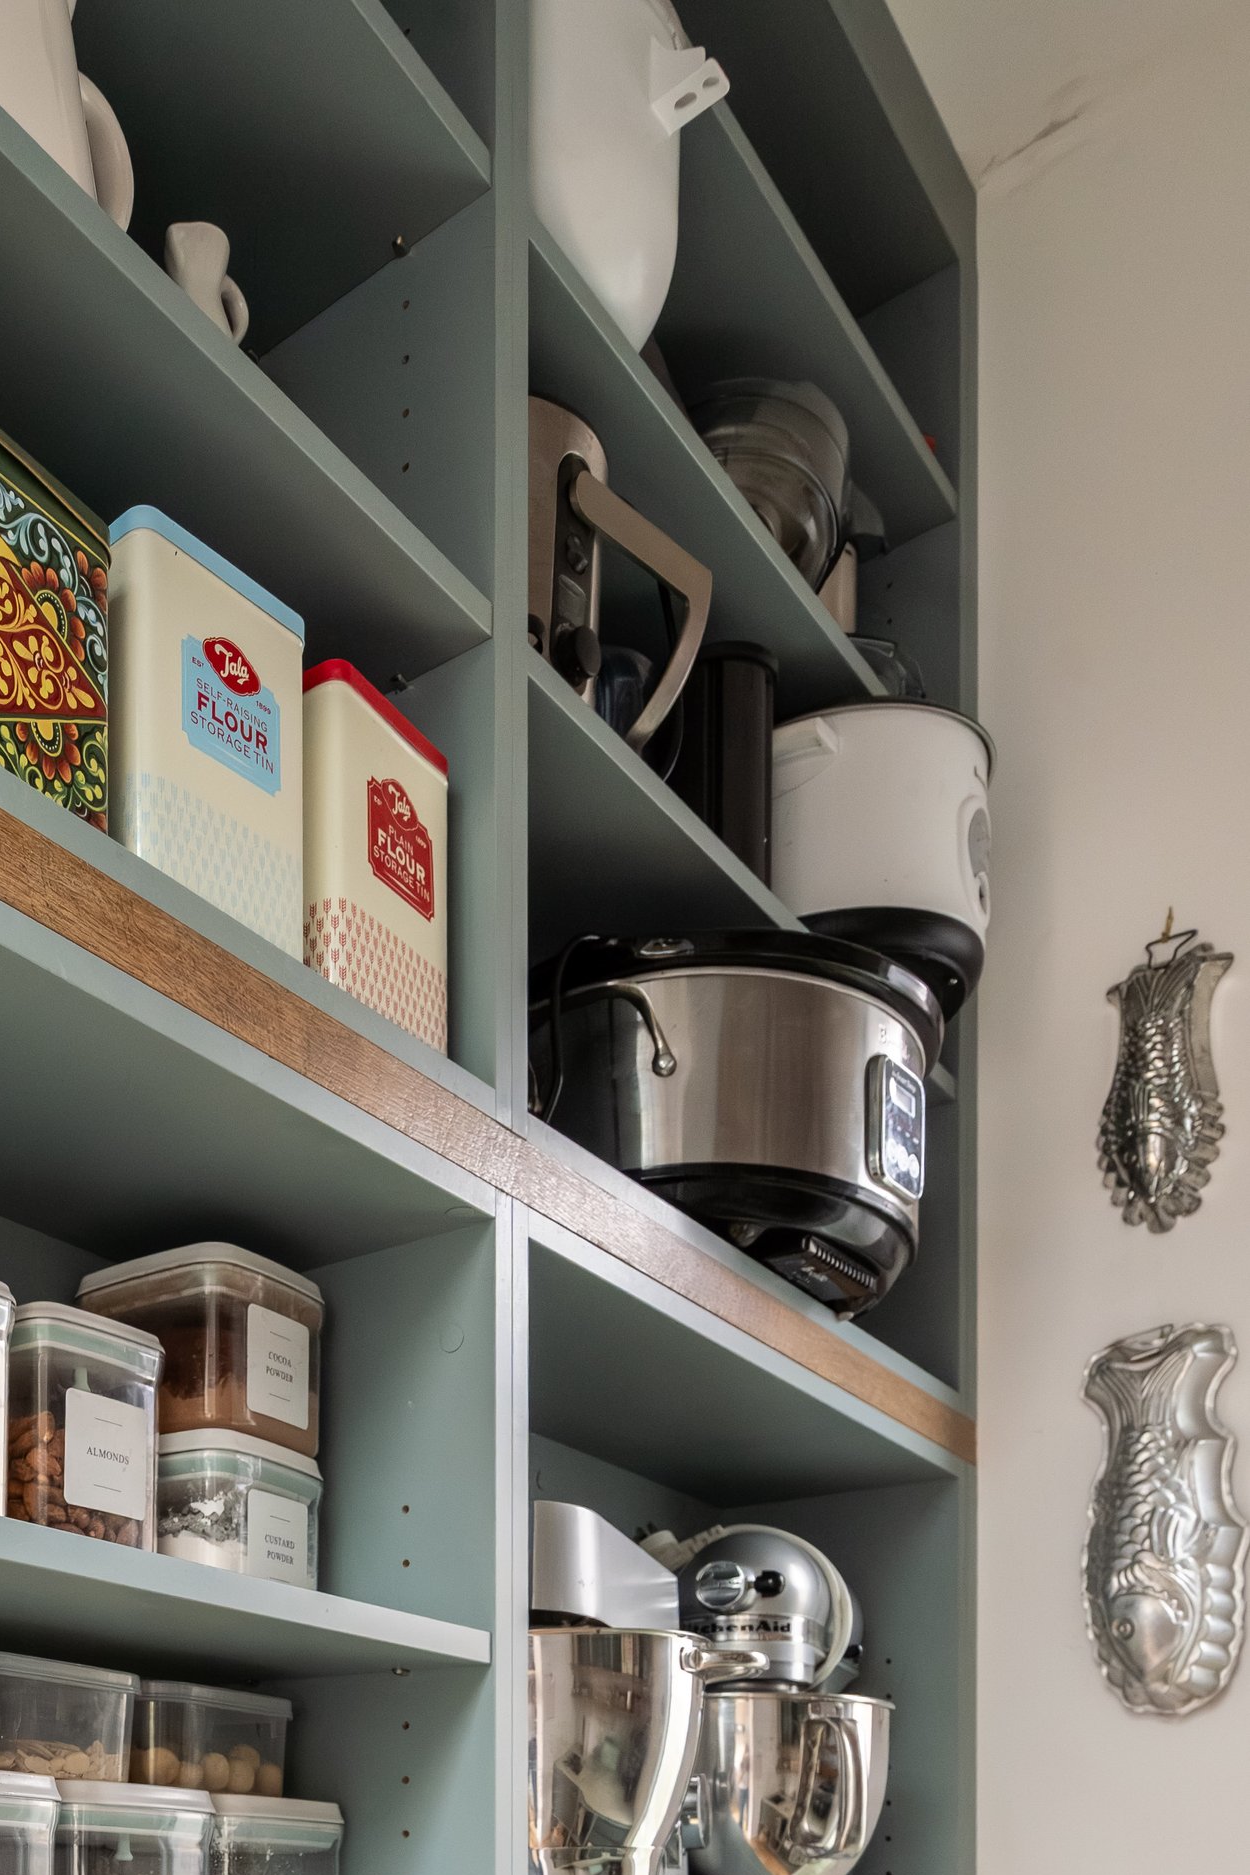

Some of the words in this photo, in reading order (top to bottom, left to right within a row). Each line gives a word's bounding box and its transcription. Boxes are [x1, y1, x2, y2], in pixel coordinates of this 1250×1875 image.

[214, 643, 250, 685] Tala
[196, 677, 268, 732] SELF-RAISING
[255, 700, 272, 715] 1899
[197, 691, 268, 754] FLOUR
[191, 711, 251, 758] STORAGE
[253, 751, 275, 774] TIN
[388, 784, 411, 822] Tala
[378, 828, 426, 885] FLOUR
[388, 825, 414, 856] PLAIN
[373, 845, 415, 889] STORAGE
[415, 880, 430, 902] TIN
[265, 1366, 294, 1383] POWDER
[268, 1351, 292, 1368] COCOA
[86, 1446, 130, 1465] ALMONDS
[264, 1534, 295, 1550] CUSTARD
[267, 1550, 295, 1566] POWDER
